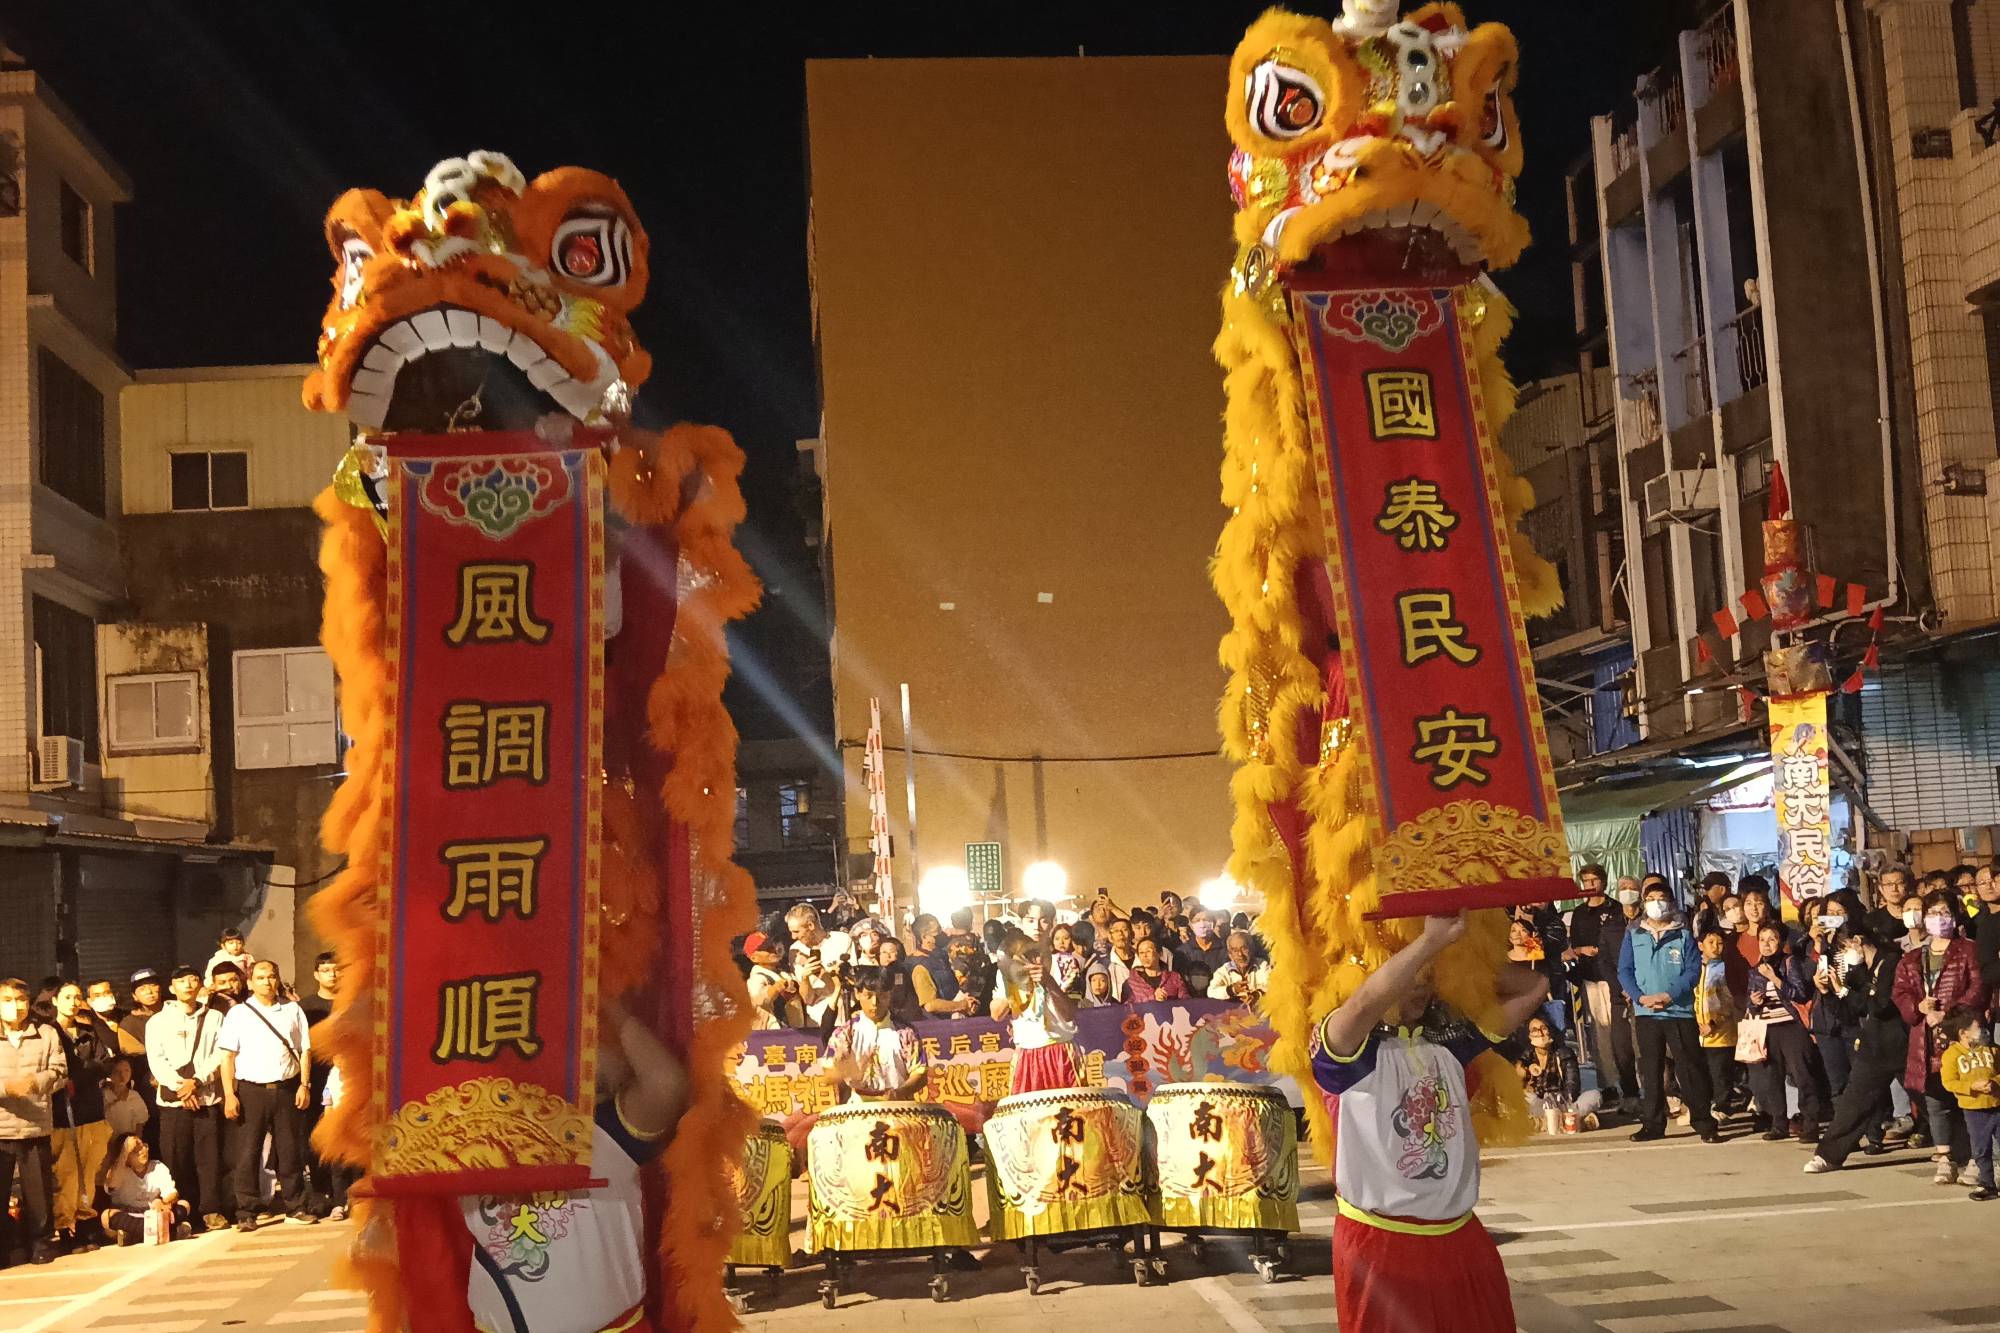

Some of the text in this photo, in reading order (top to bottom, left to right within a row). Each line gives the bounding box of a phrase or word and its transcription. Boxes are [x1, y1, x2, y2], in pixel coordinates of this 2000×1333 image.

[1364, 370, 1501, 791] 國泰民安
[434, 559, 550, 1062] 風調雨順
[729, 1074, 838, 1115] 媽祖
[762, 1032, 1001, 1066] 臺南 天后宮
[864, 1120, 901, 1214] 南大
[1051, 1106, 1089, 1195] 南大
[1189, 1100, 1224, 1193] 南大
